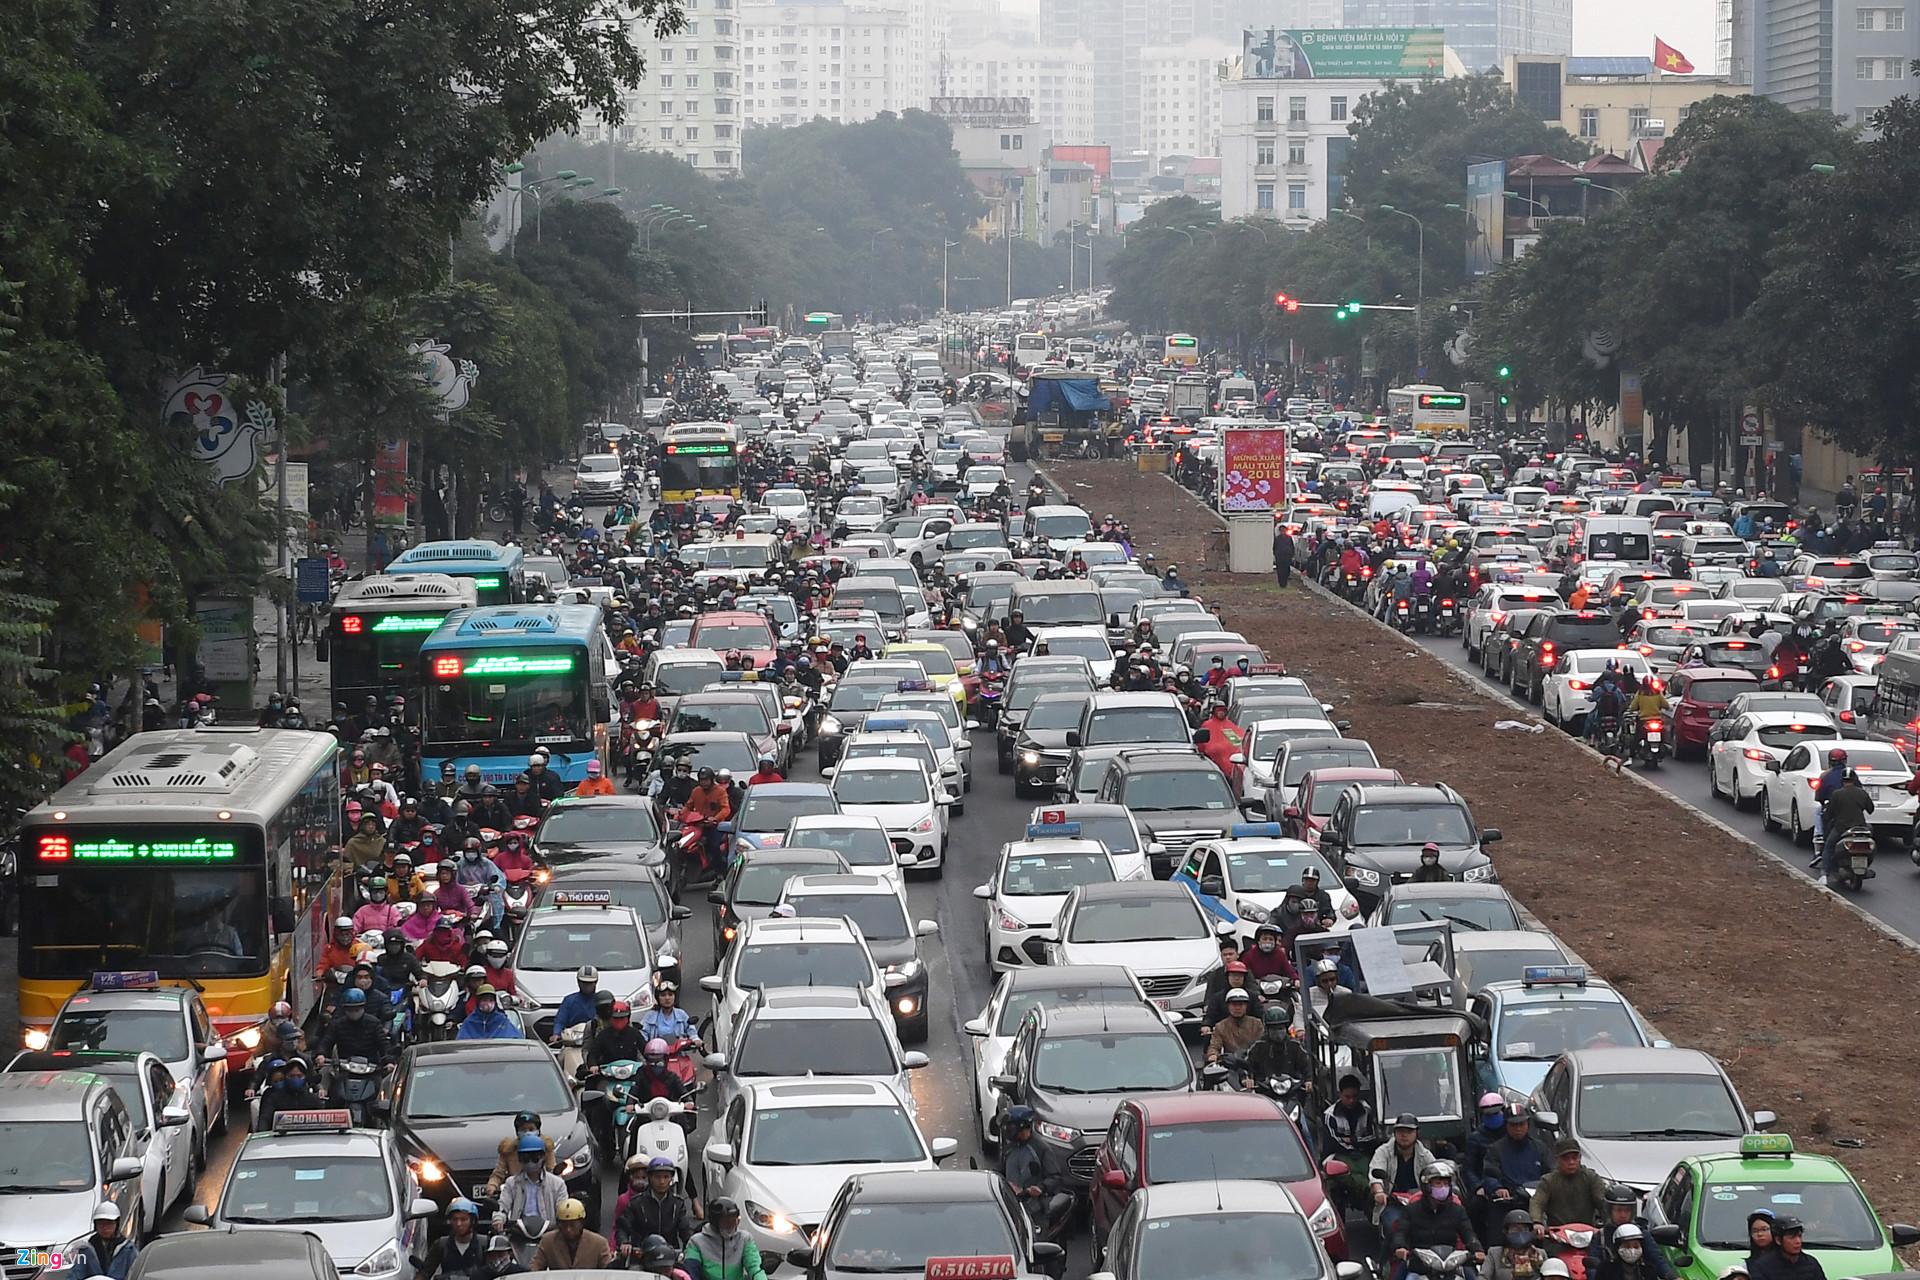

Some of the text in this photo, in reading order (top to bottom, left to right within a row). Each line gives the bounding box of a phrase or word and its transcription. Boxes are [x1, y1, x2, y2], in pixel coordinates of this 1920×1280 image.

[1316, 33, 1337, 42] BỆNH
[1338, 33, 1356, 42] VIỆN
[930, 97, 1030, 113] KYMDAN
[1248, 470, 1280, 479] 2018
[594, 894, 609, 902] SAO
[931, 1262, 1010, 1277] 6.516.516
